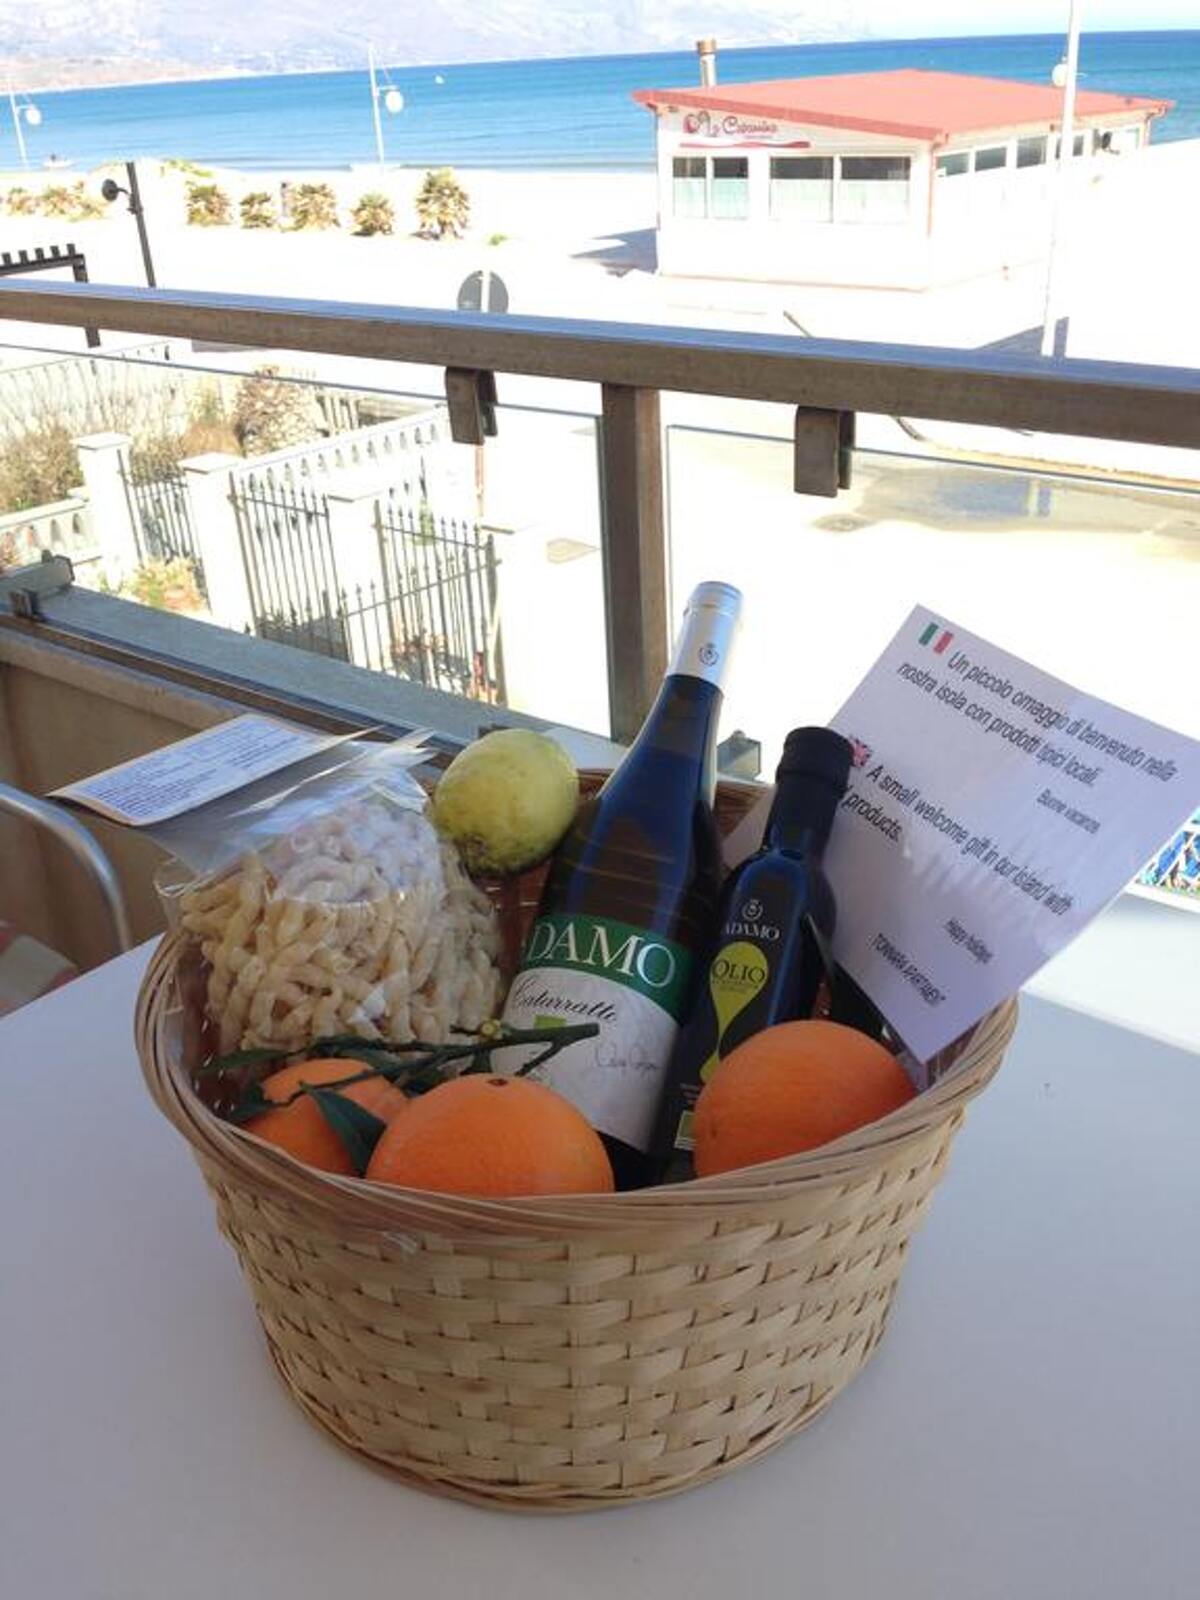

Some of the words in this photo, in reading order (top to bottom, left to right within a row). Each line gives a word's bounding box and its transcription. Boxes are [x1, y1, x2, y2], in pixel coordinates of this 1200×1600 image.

[897, 661, 937, 695] nostra
[935, 679, 966, 711] isola
[965, 701, 989, 725] con
[985, 714, 1042, 754] prodotti
[1035, 742, 1069, 772] tipici
[947, 651, 965, 673] Un
[963, 662, 1013, 700] piccolo
[1011, 688, 1070, 731] omaggio
[1065, 716, 1085, 735] di
[1076, 723, 1148, 768] benvenuto
[1144, 755, 1178, 783] nella
[866, 765, 884, 782] A
[879, 774, 921, 807] small
[914, 799, 968, 844] welcome
[961, 833, 991, 861] gift
[982, 845, 999, 867] in
[993, 856, 1017, 881] our
[1012, 866, 1051, 903] island
[1042, 890, 1076, 917] with
[522, 921, 676, 989] DAMO
[711, 959, 766, 983] OLIO
